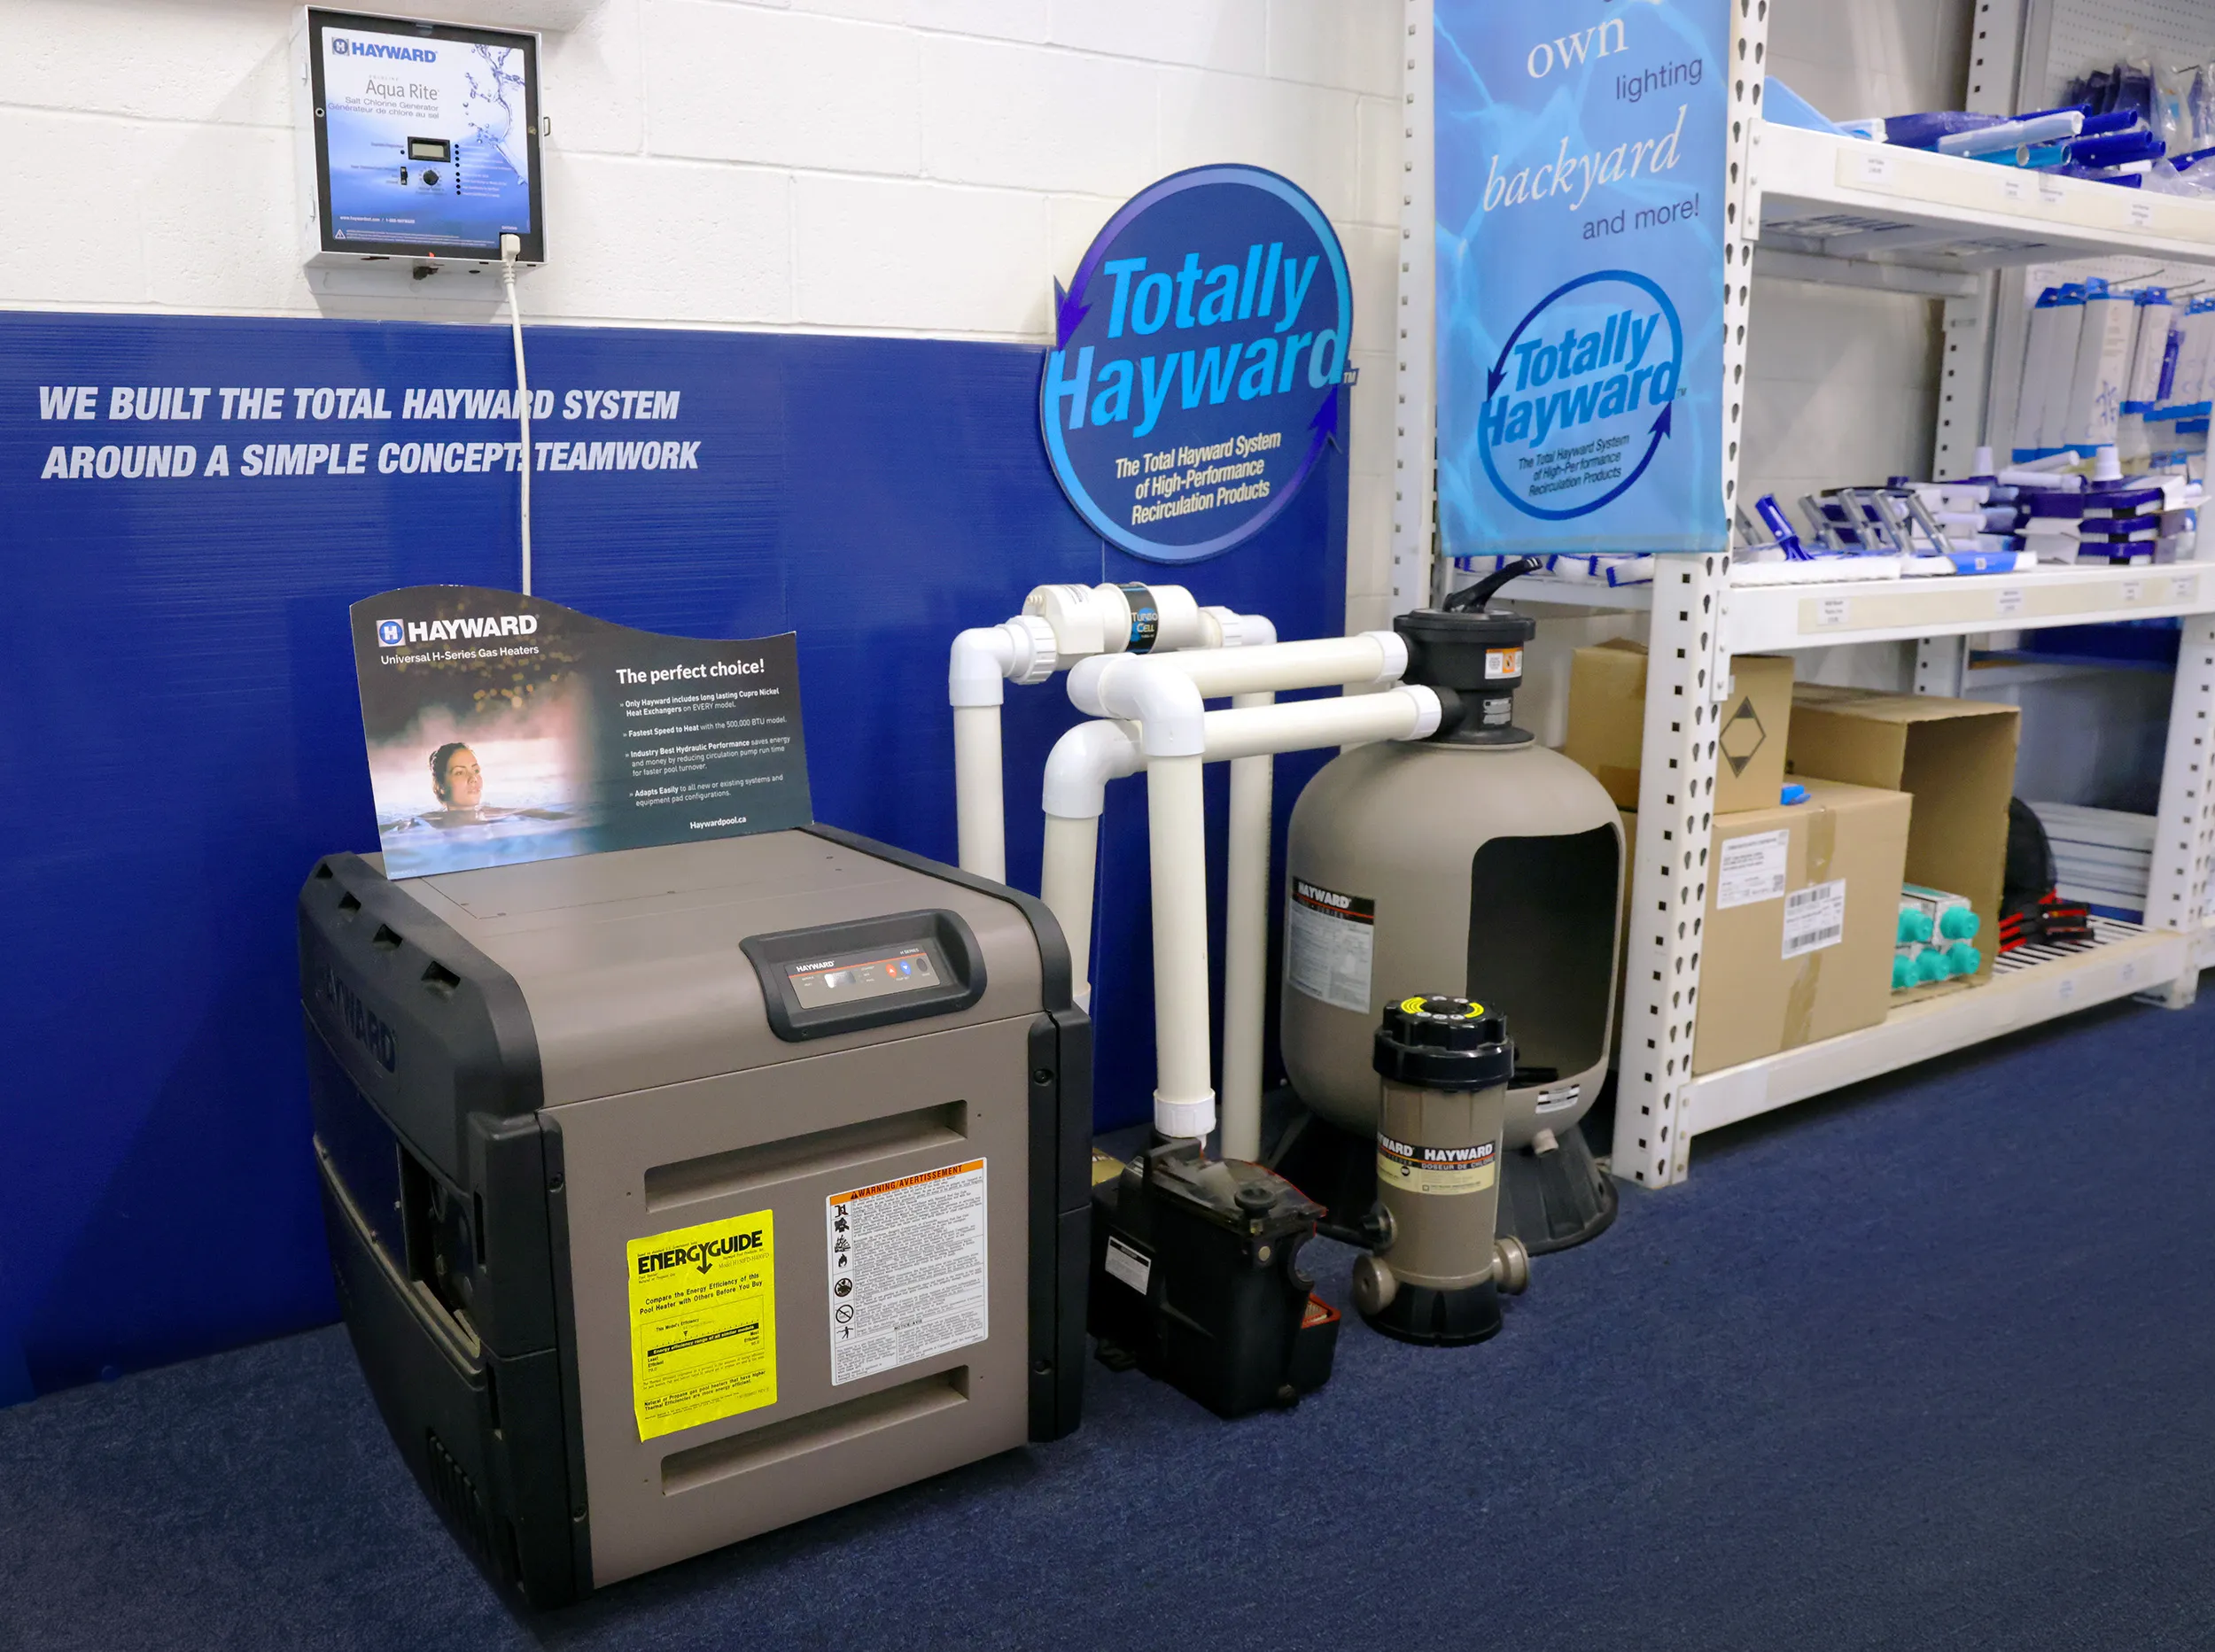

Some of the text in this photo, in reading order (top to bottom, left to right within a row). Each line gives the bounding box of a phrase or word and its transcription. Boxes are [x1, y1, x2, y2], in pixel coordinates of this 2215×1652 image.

[352, 42, 437, 63] HAYWARD
[1527, 16, 1629, 79] own
[365, 79, 438, 100] Aqua Rite
[1616, 58, 1703, 103] lighting
[328, 103, 373, 112] Générateur
[389, 108, 414, 117] chlore
[363, 98, 397, 107] Chlorine
[400, 102, 439, 112] Generator
[1482, 103, 1688, 212] backyard
[1582, 193, 1699, 240] and more!
[1103, 242, 1320, 339] Totally
[1514, 310, 1660, 392] Totally
[1045, 328, 1346, 438] Hayward
[39, 386, 680, 421] WE BUILT THE TOTAL HAYWARD SYSTEM
[1479, 361, 1675, 448] Hayward
[41, 446, 197, 479] AROUND
[204, 446, 229, 477] A
[240, 444, 369, 476] SIMPLE
[534, 441, 702, 471] TEAMWORK
[1115, 432, 1282, 478] The Total Hayward System
[1519, 434, 1630, 470] The Total Hayward System
[1135, 459, 1265, 500] of High-Performance
[1533, 452, 1621, 481] of High-Performance
[1528, 467, 1622, 497] Recirculation Products
[1131, 479, 1271, 525] Recirculation Products
[408, 615, 538, 642] HAYWARD
[1131, 611, 1158, 622] TURBO
[1137, 623, 1154, 632] CELL
[381, 646, 540, 665] Universal H-Series Gas Heaters
[616, 658, 765, 685] The perfect choice!
[625, 687, 780, 709] Only Hayward includes long lasting Cupro Nickel
[643, 706, 682, 717] Exchangers
[693, 702, 713, 711] EVERY
[714, 701, 736, 710] model.
[628, 727, 654, 738] Fastest
[654, 725, 675, 736] Speed
[727, 719, 750, 728] 500,000
[751, 717, 766, 726] BTU
[766, 716, 787, 725] model.
[630, 748, 659, 758] Industry
[659, 747, 675, 756] Best
[675, 743, 708, 754] Hydraulic
[708, 740, 750, 751] Performance
[769, 736, 791, 746] energy
[645, 758, 667, 767] money
[667, 756, 676, 765] by
[677, 753, 705, 764] reducing
[705, 749, 739, 760] circulation
[642, 767, 663, 776] faster
[664, 765, 679, 774] pool
[679, 763, 708, 772] turnover.
[634, 787, 658, 797] Adapts
[659, 786, 679, 795] Easily
[719, 778, 744, 788] existing
[744, 776, 771, 786] systems
[635, 789, 731, 807] equipment pad configurations.
[690, 816, 747, 829] Haywardpool.ca
[1299, 882, 1349, 909] HAYWARD
[797, 961, 834, 972] HAYWARD
[1425, 1144, 1493, 1161] HAYWARD
[638, 1229, 763, 1275] ENERGYGUIDE
[640, 1306, 654, 1315] Pool
[656, 1302, 676, 1311] Heater
[694, 1292, 714, 1301] Others
[716, 1287, 736, 1297] Before
[645, 1295, 672, 1305] Compare
[686, 1285, 707, 1294] Energy
[709, 1278, 738, 1290] Efficiency
